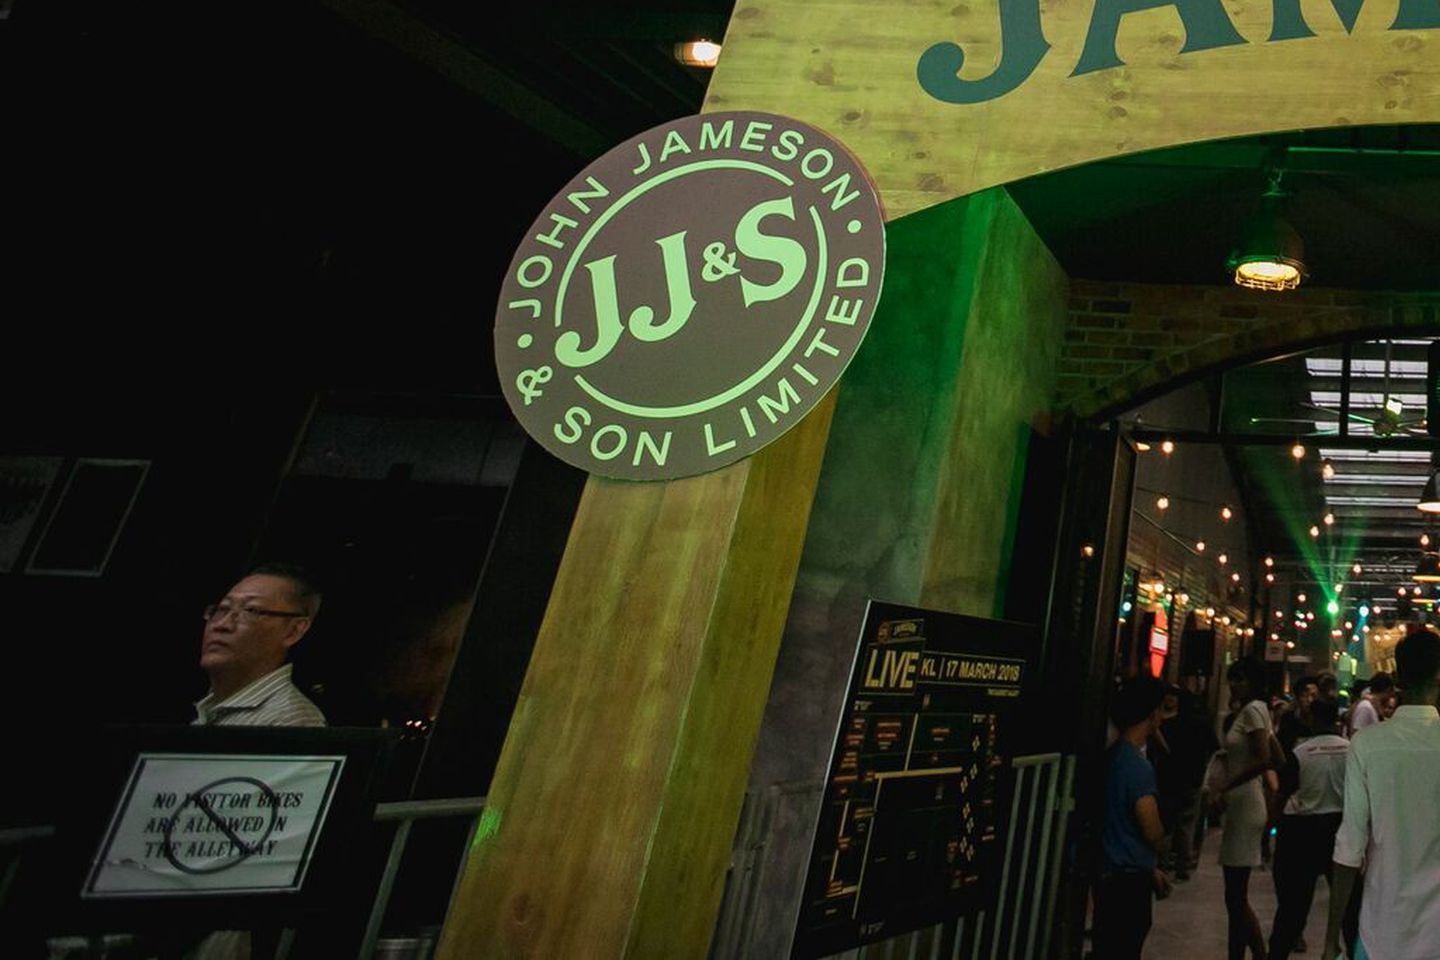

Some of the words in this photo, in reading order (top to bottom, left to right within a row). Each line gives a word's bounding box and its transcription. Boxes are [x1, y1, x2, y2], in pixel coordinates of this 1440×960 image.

[508, 176, 610, 318] JOHN
[633, 120, 861, 211] JAMESON
[554, 196, 807, 368] JJ&S
[515, 365, 553, 405] &
[554, 406, 672, 466] SON
[704, 257, 870, 456] LIMITED
[865, 649, 919, 689] LIVE
[920, 658, 936, 677] KL
[946, 660, 958, 678] 17
[959, 661, 997, 680] MARCH
[153, 793, 177, 808] NO
